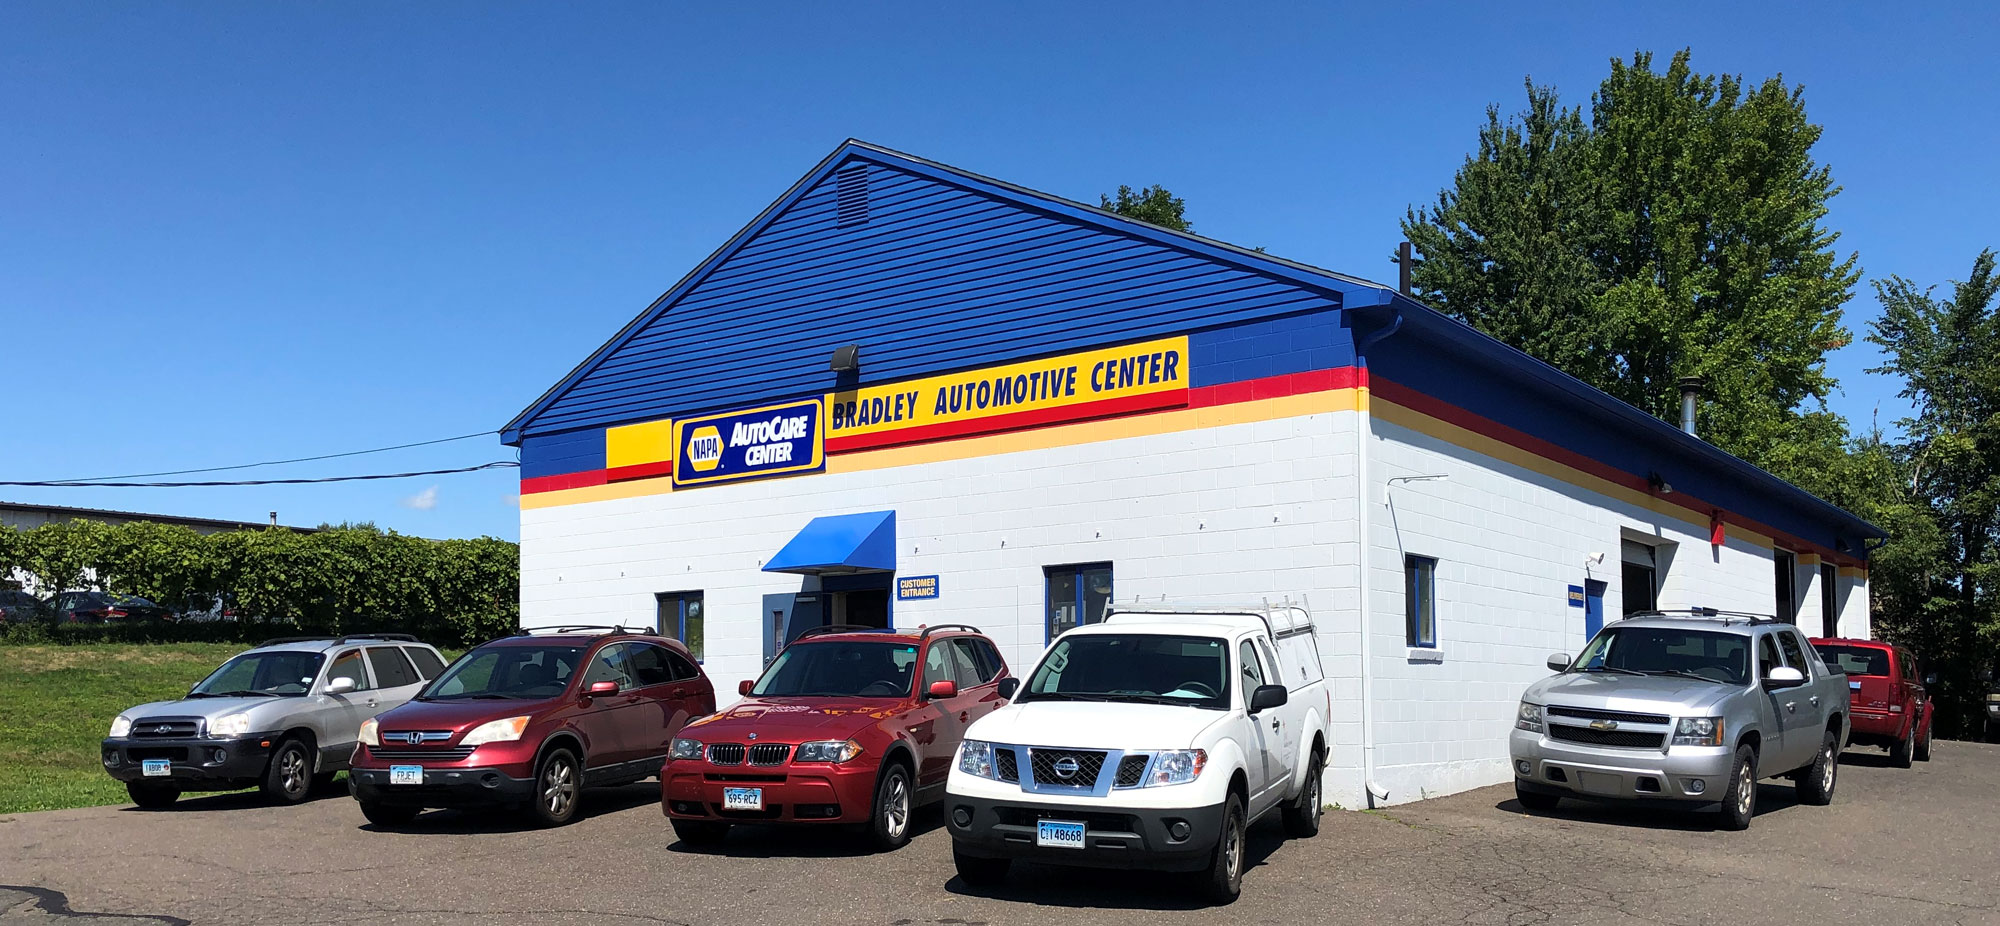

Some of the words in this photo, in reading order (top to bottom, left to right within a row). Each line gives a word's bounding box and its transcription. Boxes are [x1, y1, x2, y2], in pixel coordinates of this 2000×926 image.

[832, 391, 919, 430] BRADLEY
[933, 366, 1078, 416] AUTOMOTIVE
[1090, 350, 1179, 392] CENTER
[693, 437, 718, 460] NAPA
[745, 441, 792, 467] CENTER
[900, 578, 936, 589] CUSTOMER
[901, 587, 935, 598] ENTRANCE
